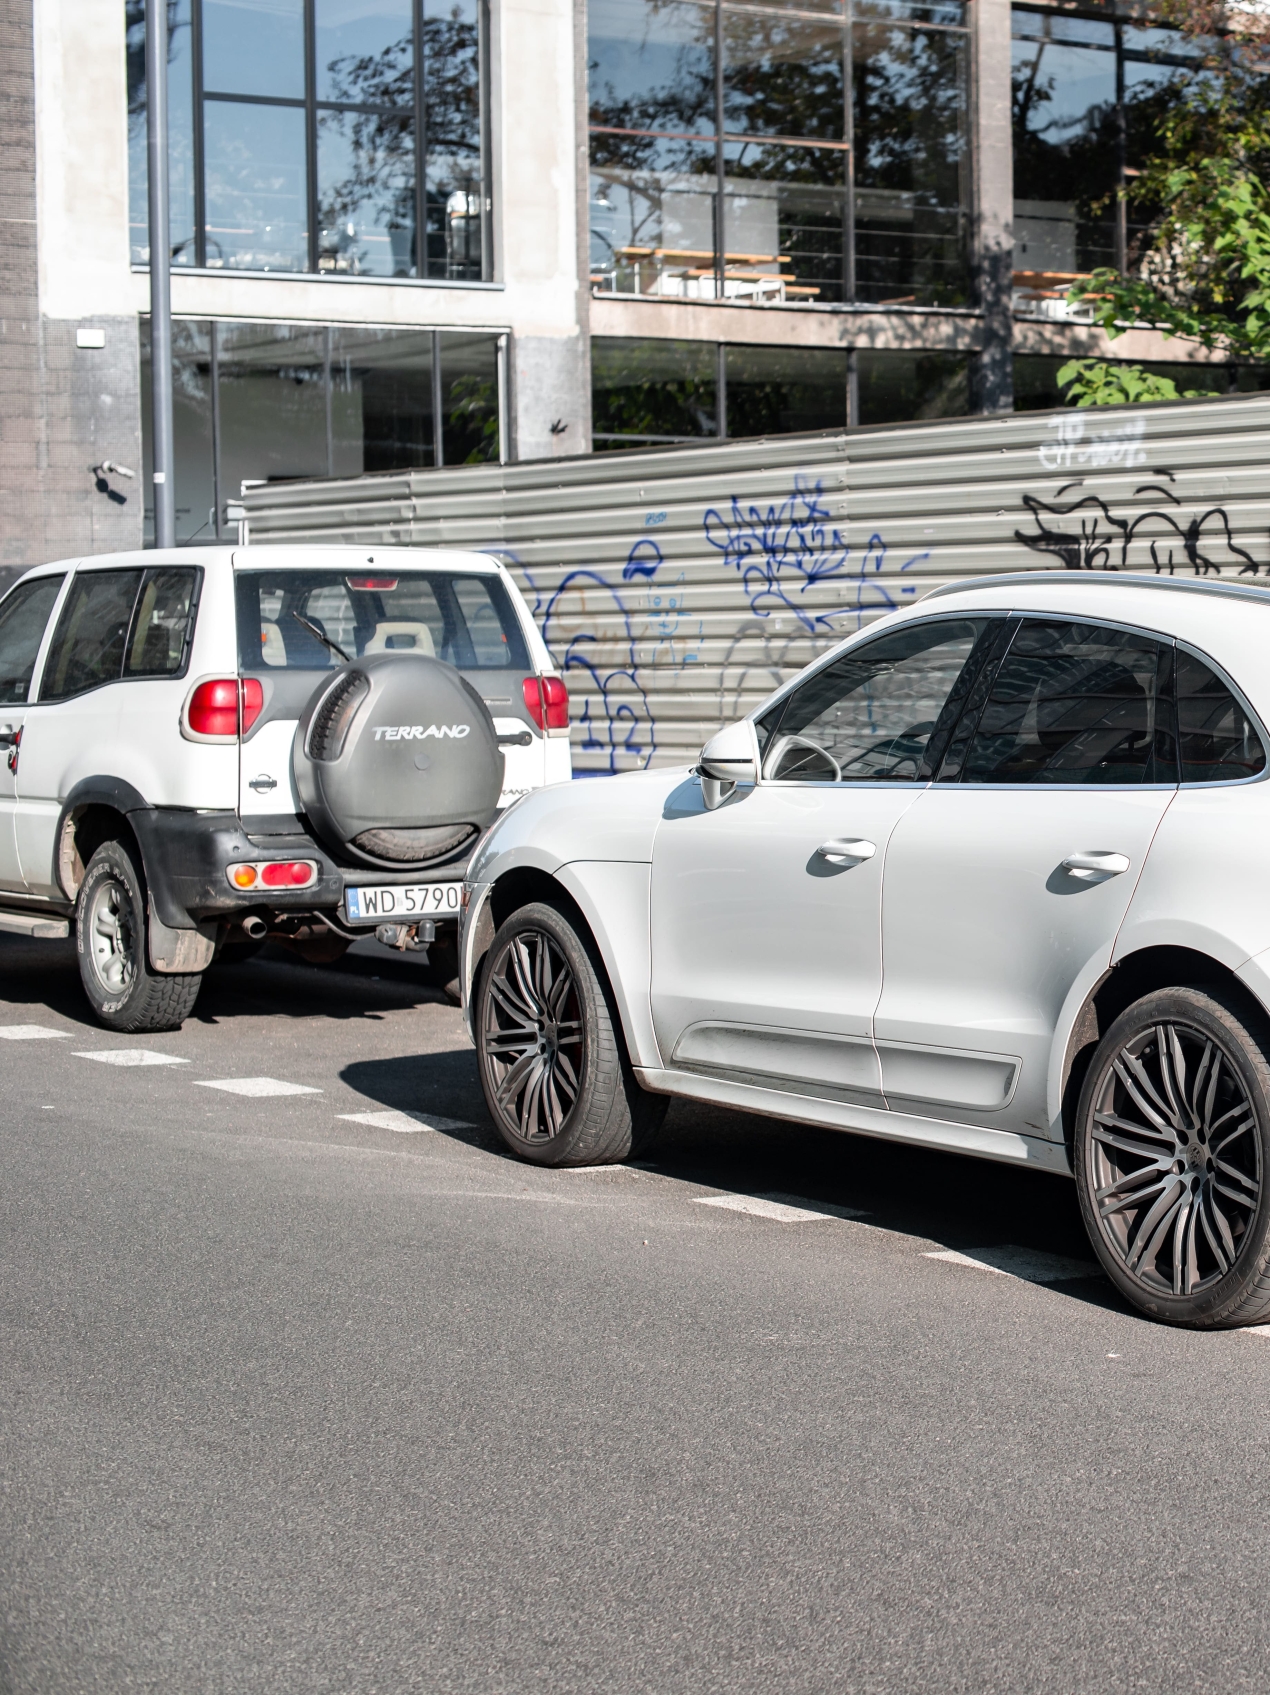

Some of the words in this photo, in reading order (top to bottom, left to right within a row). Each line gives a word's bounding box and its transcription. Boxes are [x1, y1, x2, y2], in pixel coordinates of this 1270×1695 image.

[371, 724, 471, 742] TERRANO
[362, 890, 396, 914] WD
[404, 886, 459, 912] 5790
